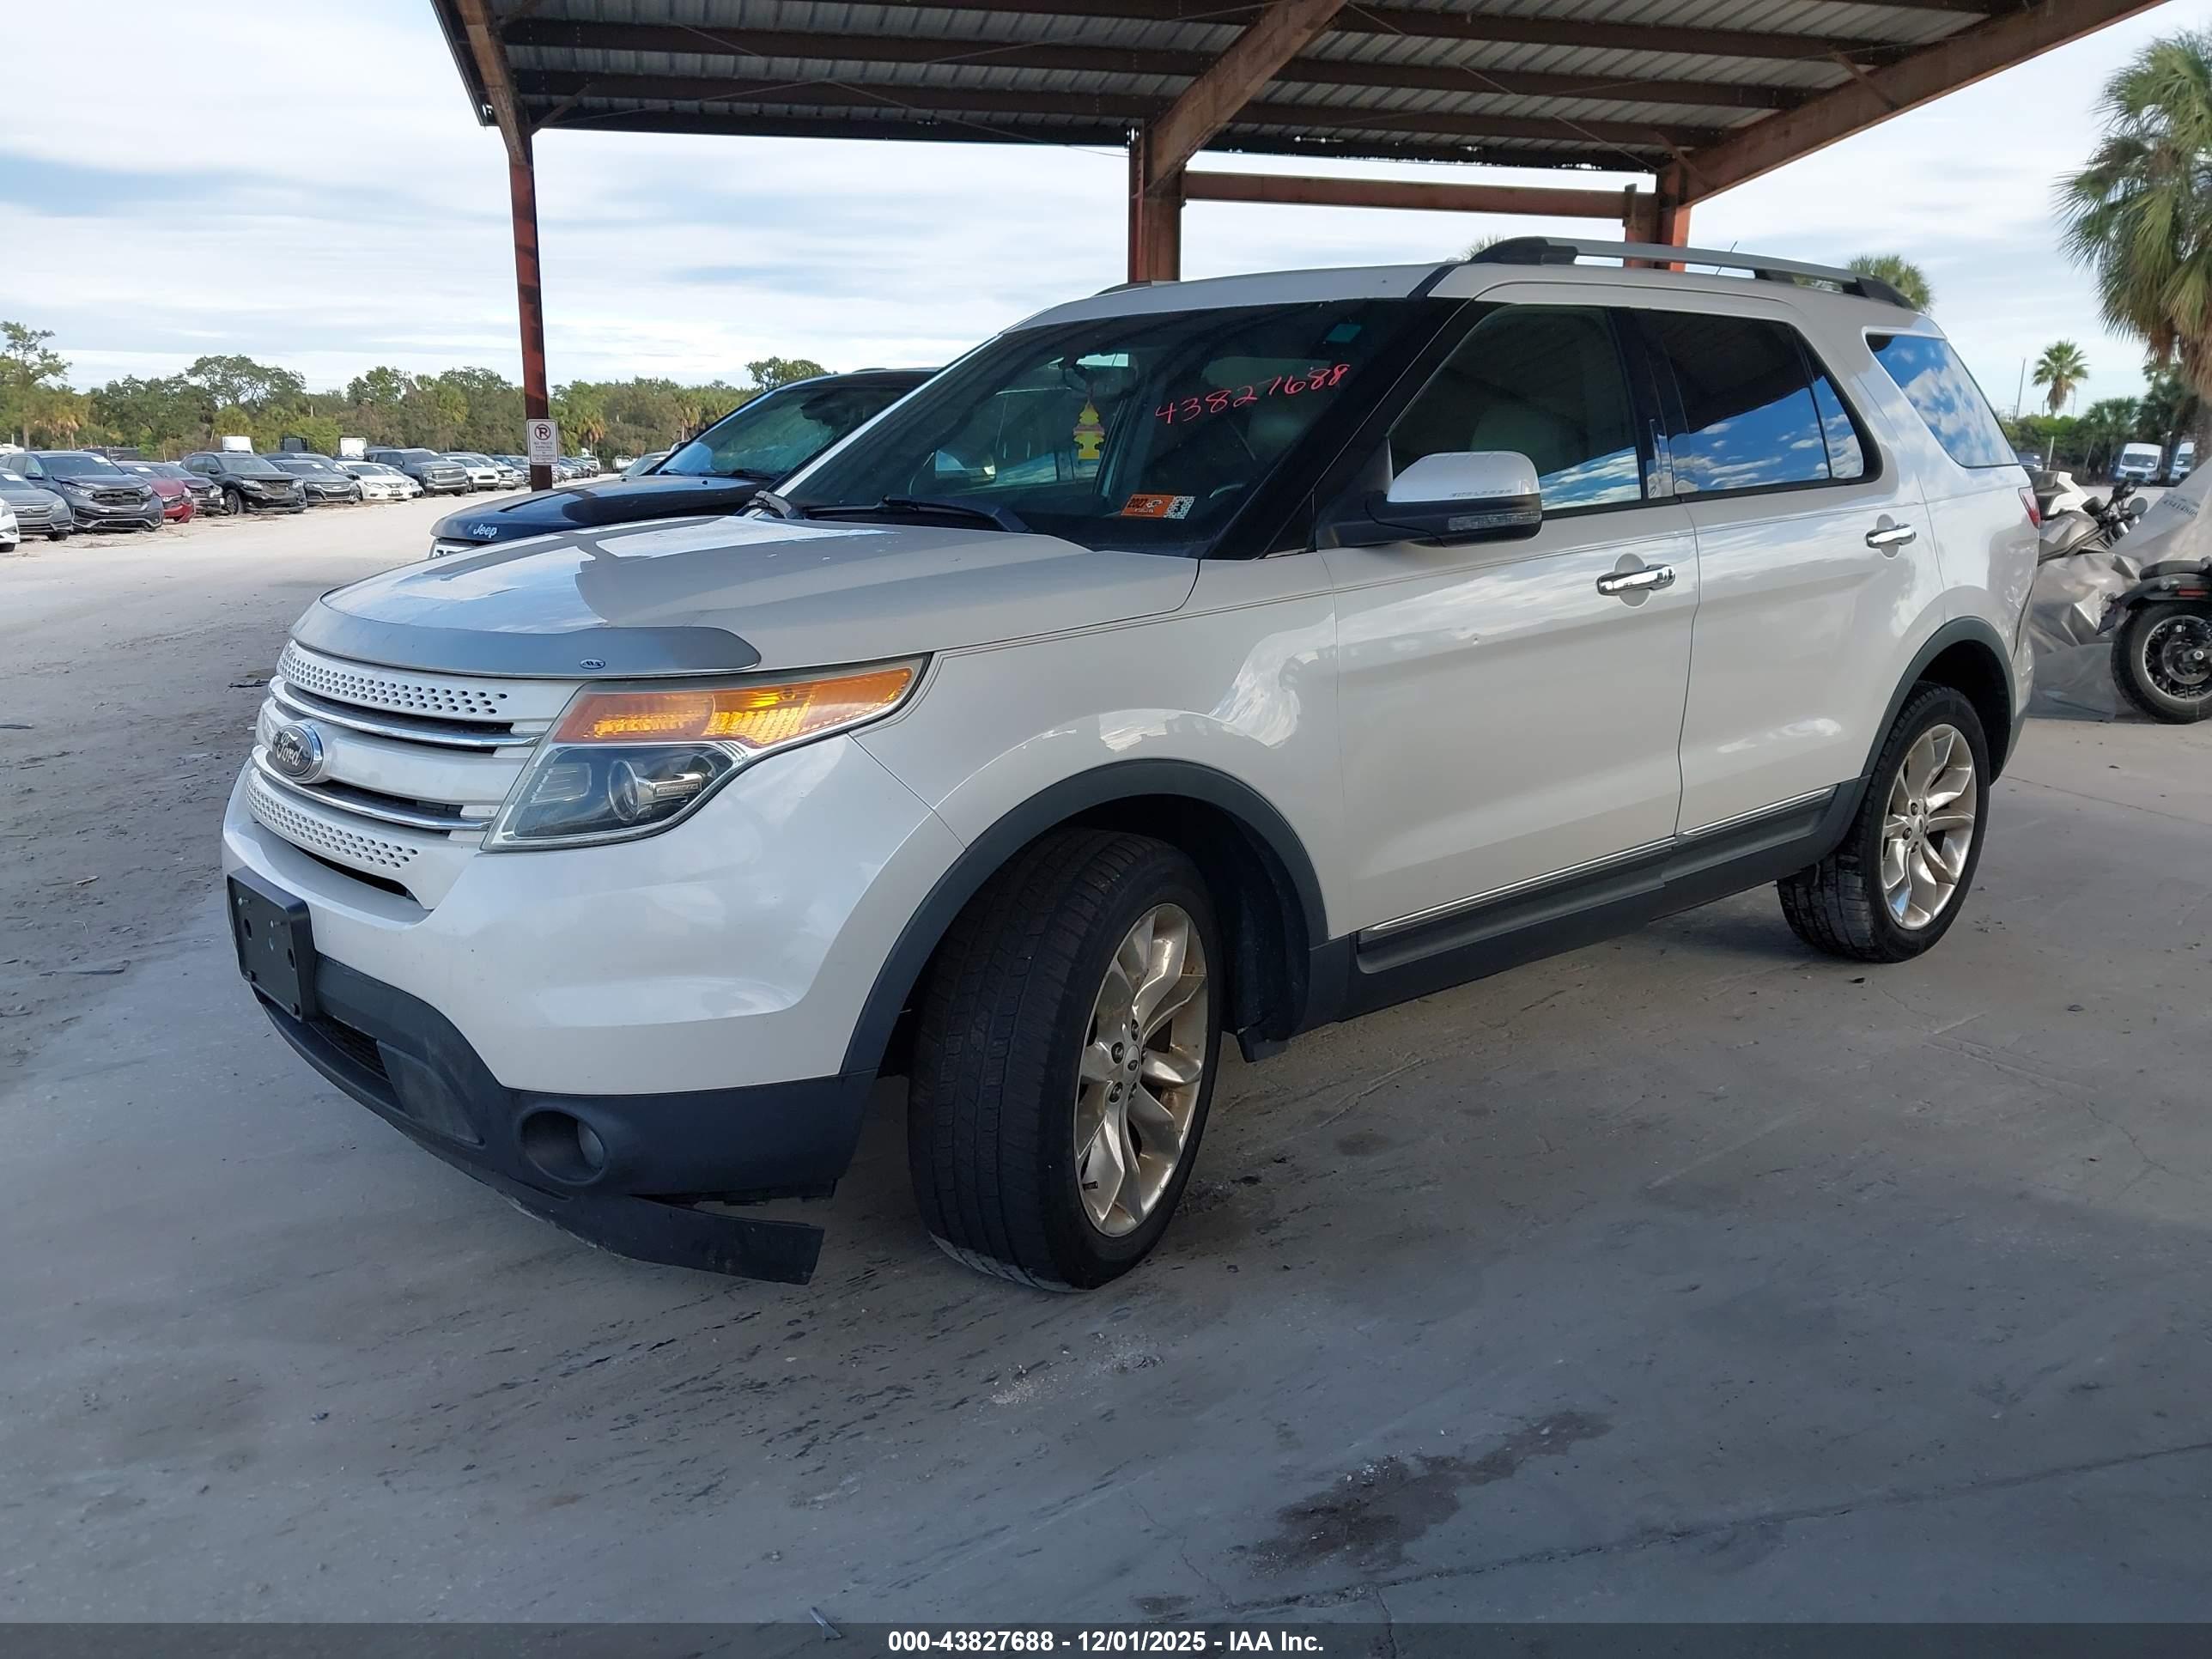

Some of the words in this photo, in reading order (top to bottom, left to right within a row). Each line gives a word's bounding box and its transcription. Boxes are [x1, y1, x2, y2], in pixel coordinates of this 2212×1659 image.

[1155, 364, 1351, 424] 43827688
[472, 523, 498, 539] Jeep
[276, 731, 304, 767] Ford
